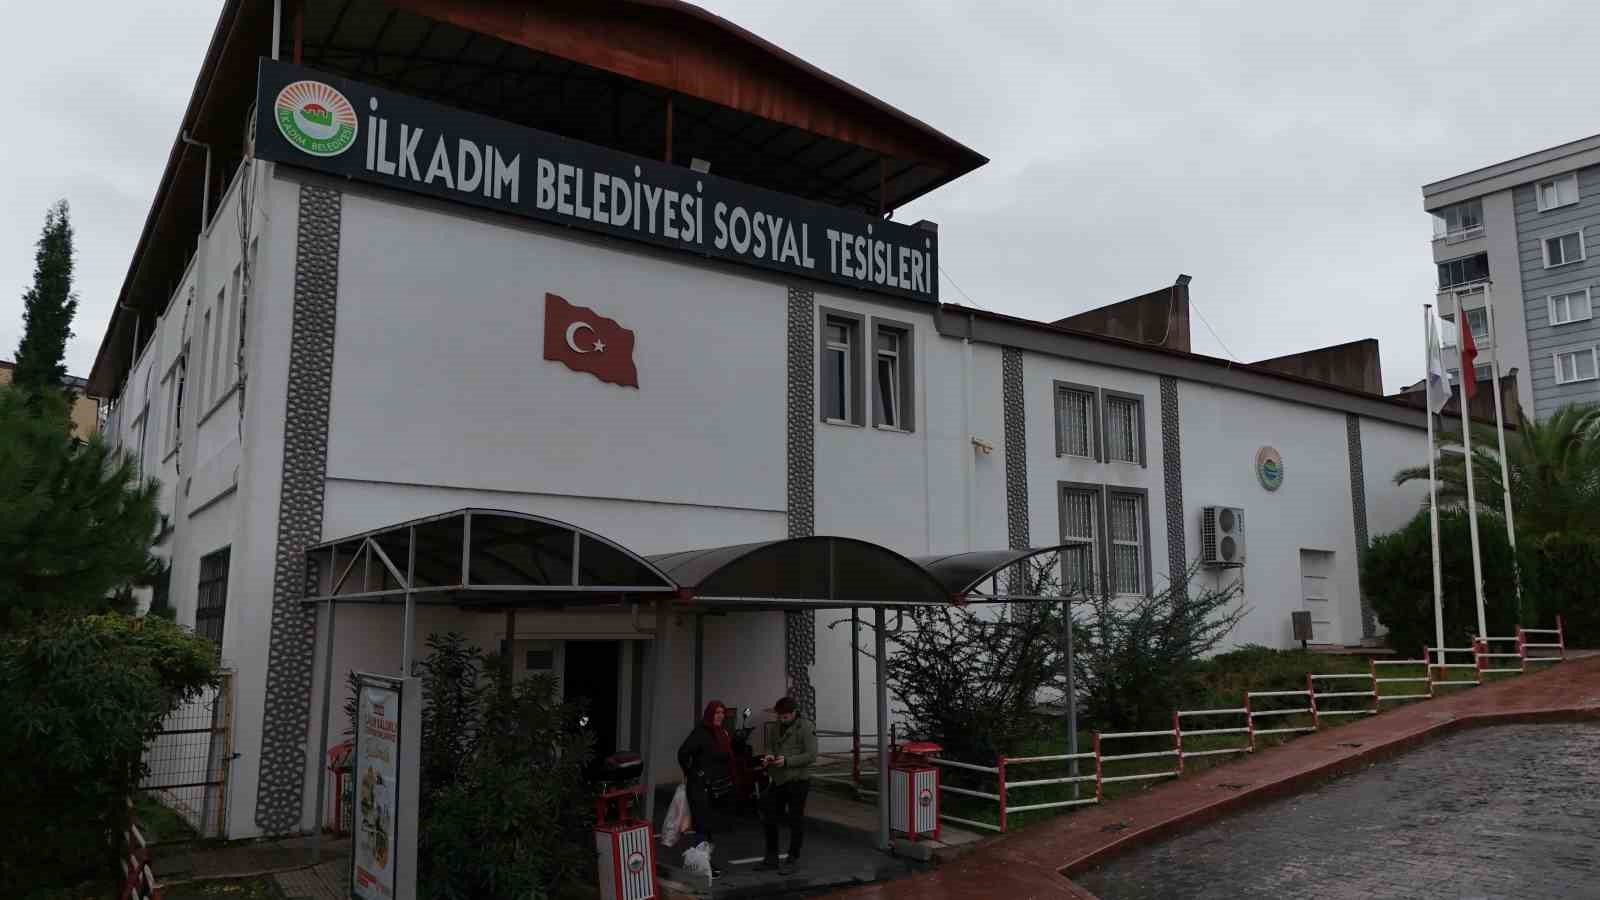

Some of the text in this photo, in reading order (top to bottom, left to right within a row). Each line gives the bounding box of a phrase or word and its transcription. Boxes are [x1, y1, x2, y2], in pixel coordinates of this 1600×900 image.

[366, 97, 932, 294] İLKADIM BELEDİYESİ SOSYAL TESİSLERİ
